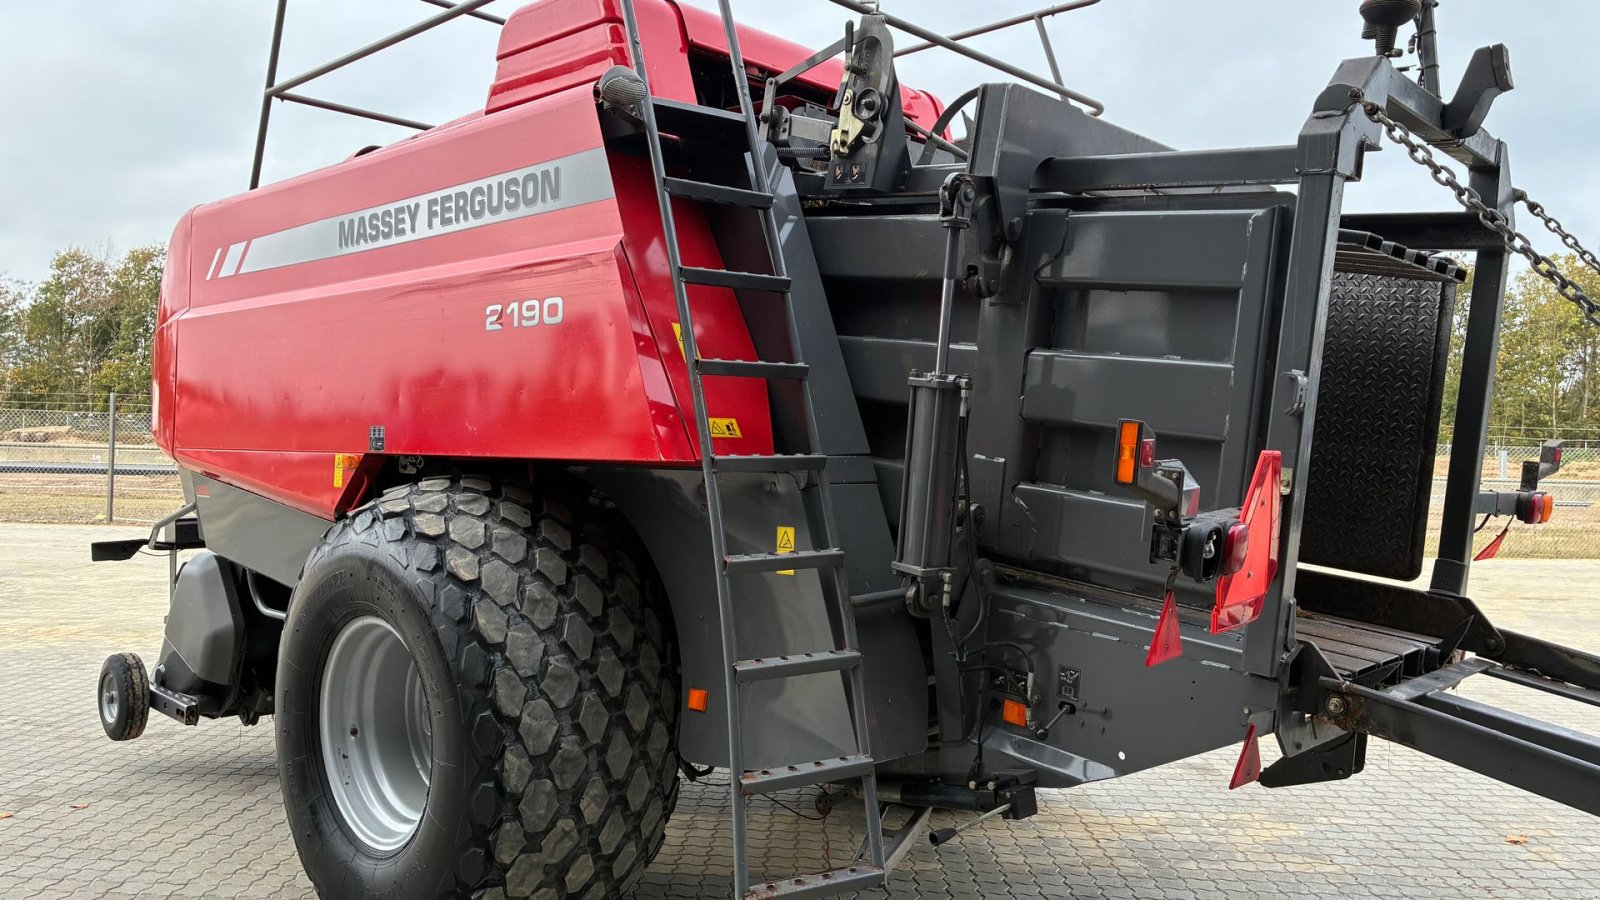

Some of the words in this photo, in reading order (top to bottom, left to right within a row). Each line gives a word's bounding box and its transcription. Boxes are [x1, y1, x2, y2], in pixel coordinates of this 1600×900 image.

[338, 202, 421, 249] MASSEY
[427, 166, 561, 230] FERGUSON
[485, 296, 564, 331] 2190
